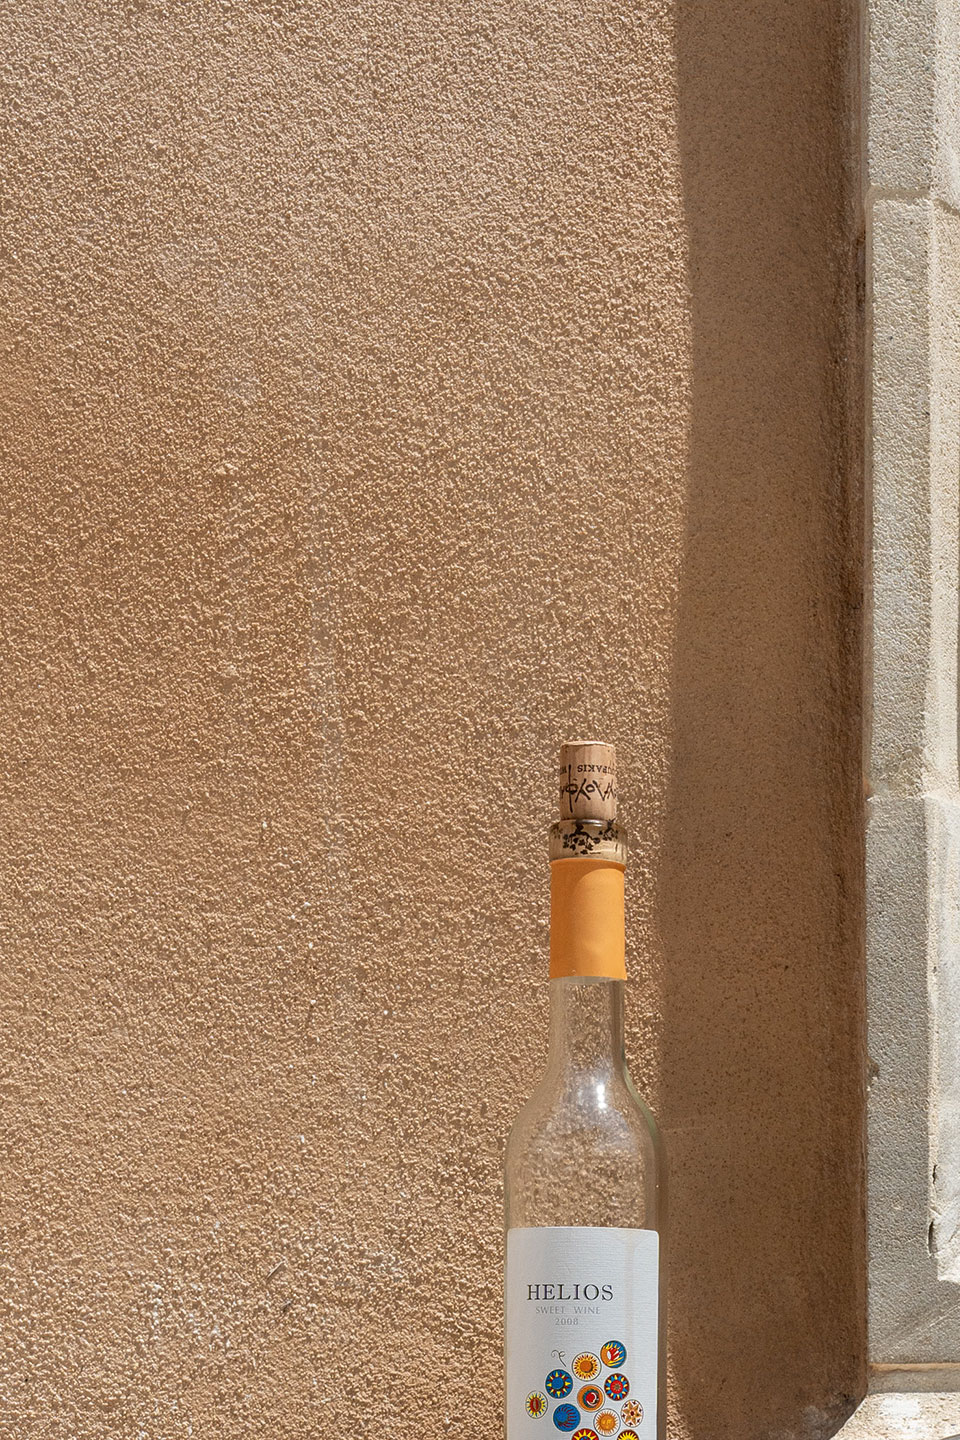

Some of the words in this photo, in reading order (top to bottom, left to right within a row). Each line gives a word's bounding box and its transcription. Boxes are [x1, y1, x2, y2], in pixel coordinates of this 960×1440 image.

[526, 1284, 614, 1301] HELIOS
[536, 1306, 566, 1314] SWEET
[574, 1306, 600, 1314] WINE
[554, 1318, 579, 1326] 2008
